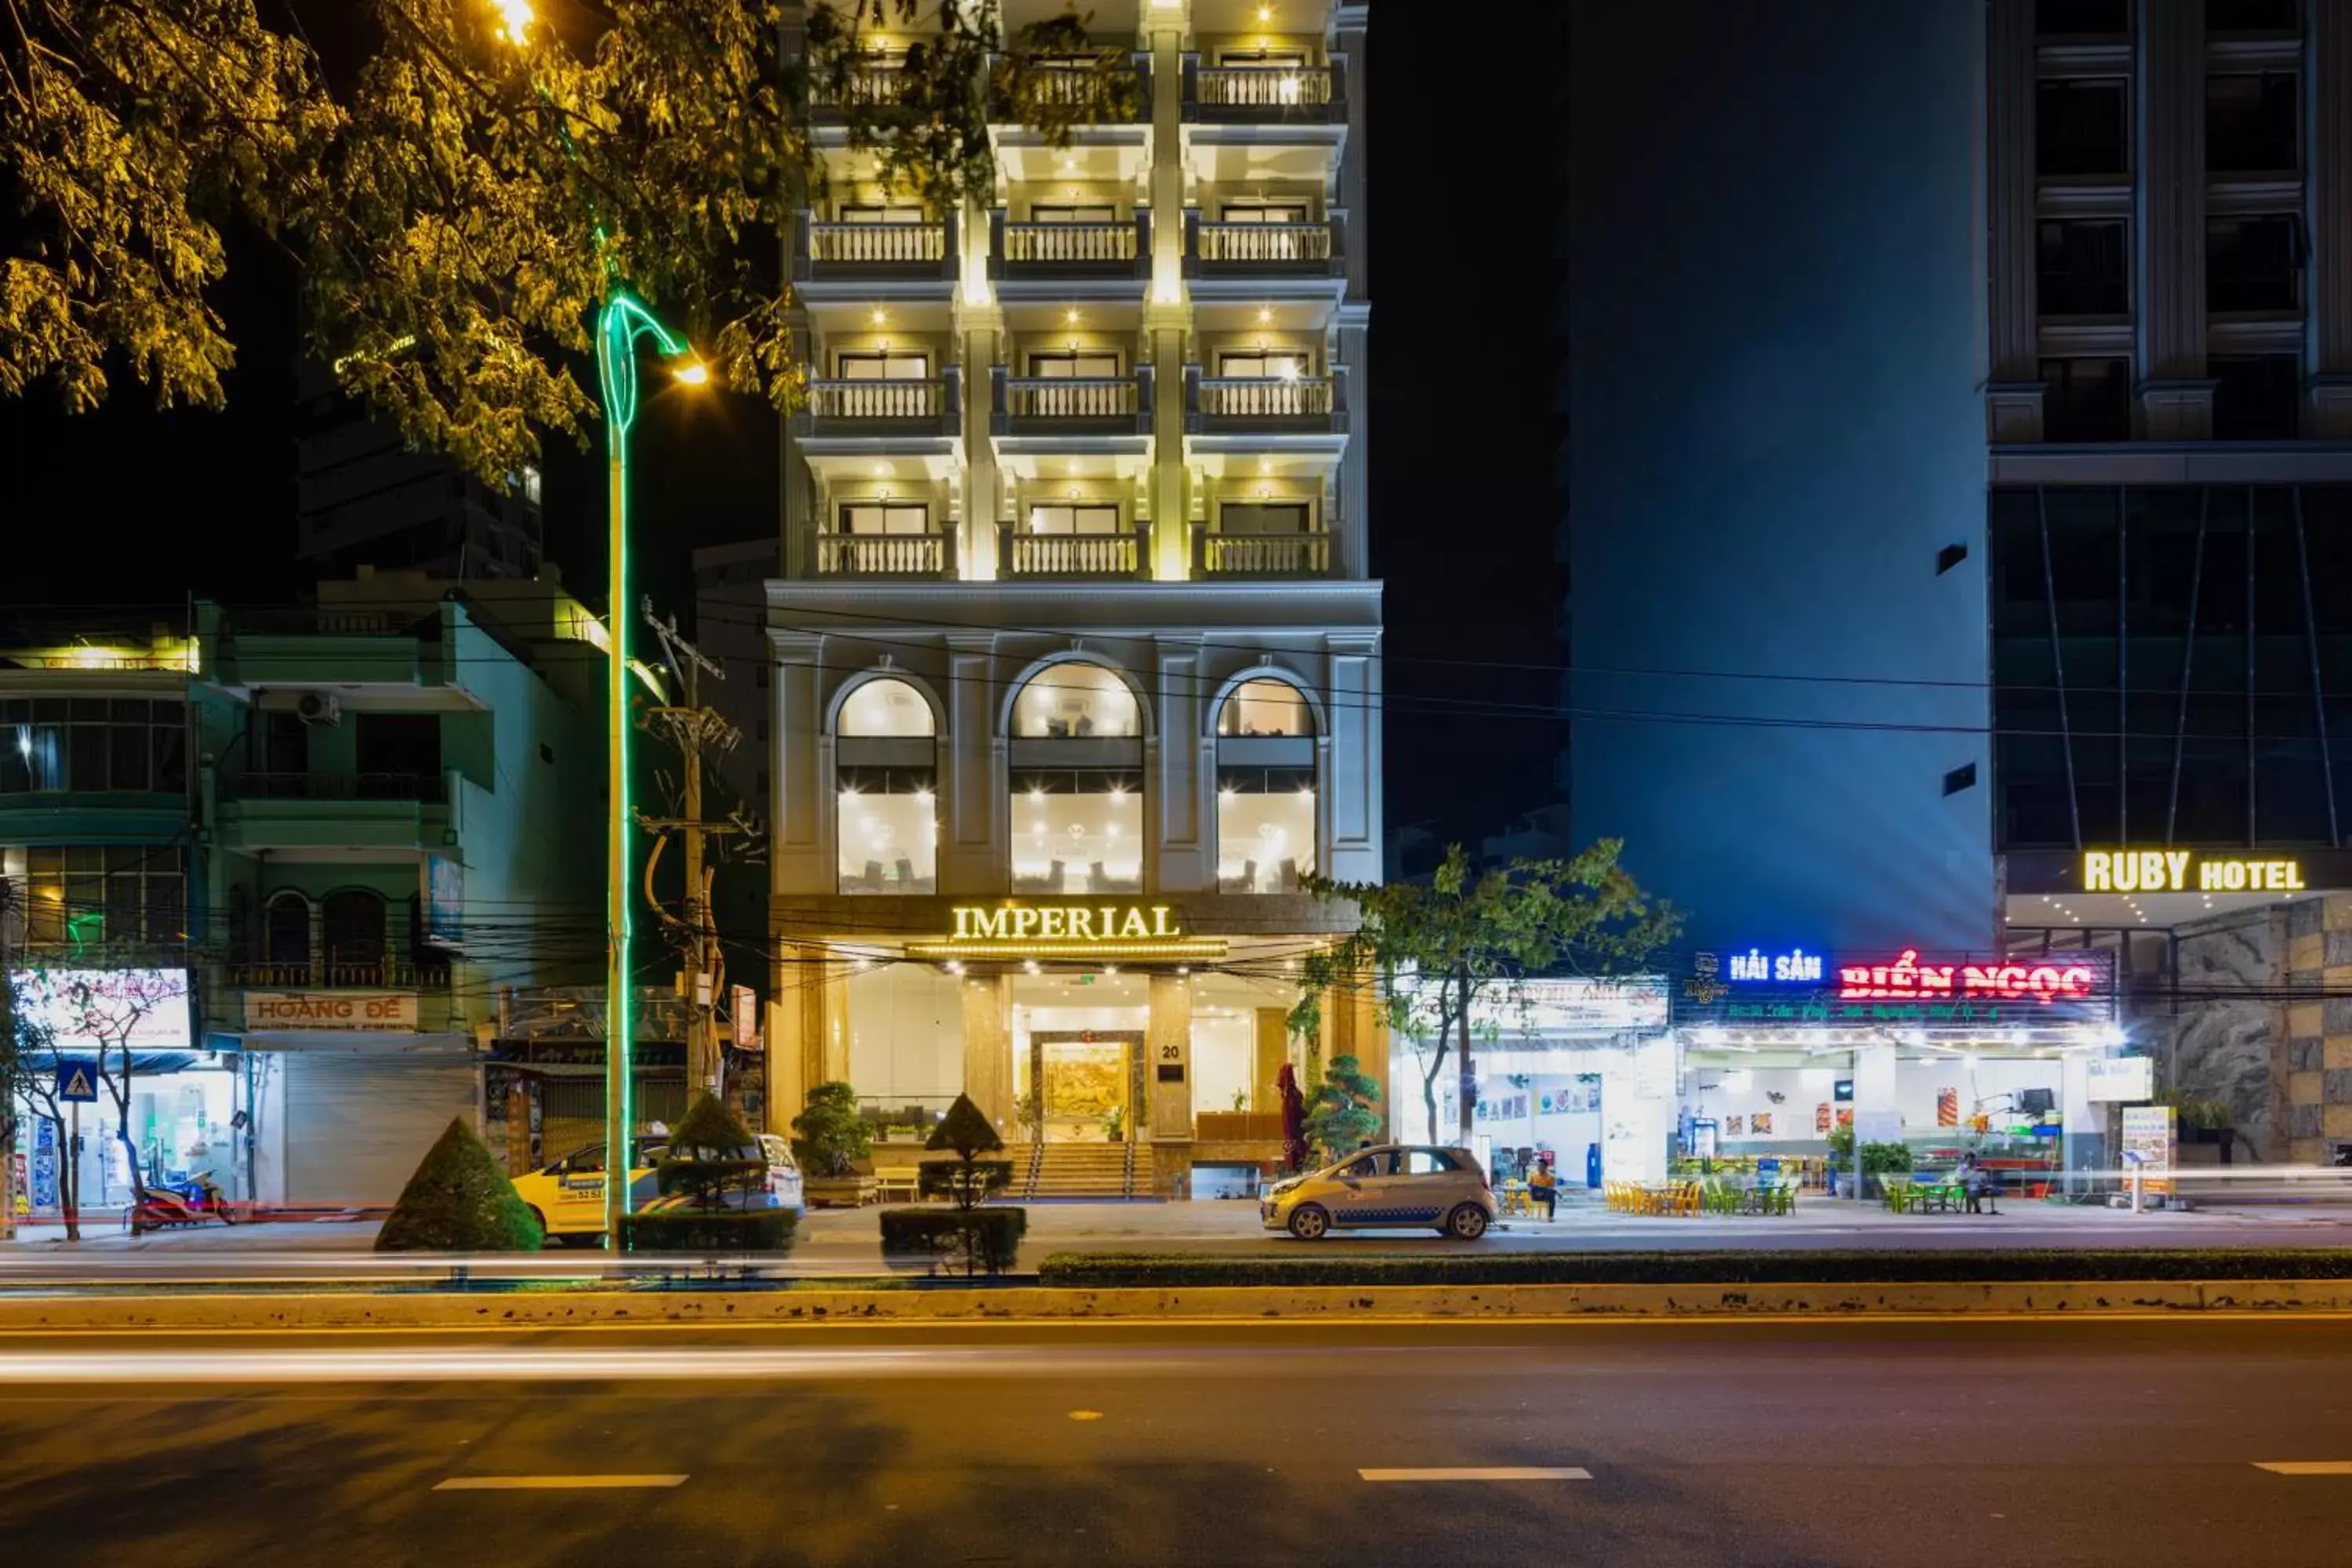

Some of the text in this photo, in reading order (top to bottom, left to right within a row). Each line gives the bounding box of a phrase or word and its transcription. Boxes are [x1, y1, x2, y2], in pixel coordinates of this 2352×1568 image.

[2085, 851, 2305, 891] RUBY HOTEL
[953, 906, 1180, 941] IMPERIAL
[1730, 948, 1821, 980] HẢI SẢN
[1840, 949, 2091, 1004] BIỂN NGỌC
[1163, 1045, 1179, 1059] 20
